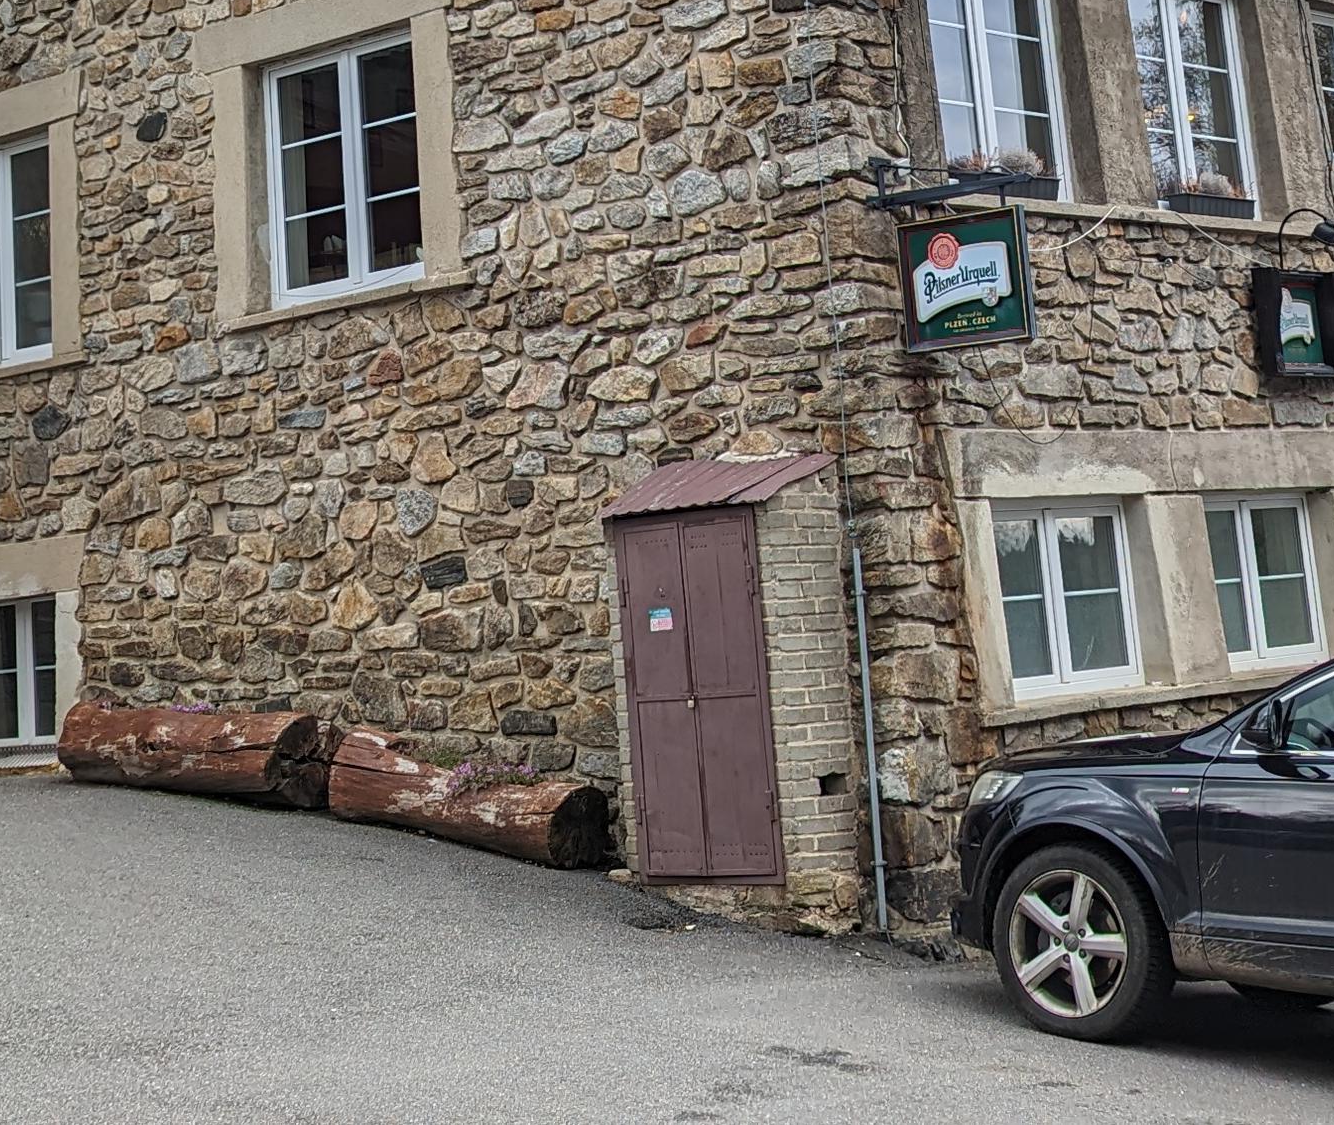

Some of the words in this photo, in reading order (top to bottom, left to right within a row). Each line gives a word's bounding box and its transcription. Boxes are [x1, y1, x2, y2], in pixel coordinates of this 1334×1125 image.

[924, 271, 961, 304] Pilsner
[959, 261, 998, 287] Urquell
[972, 315, 996, 324] CZECH
